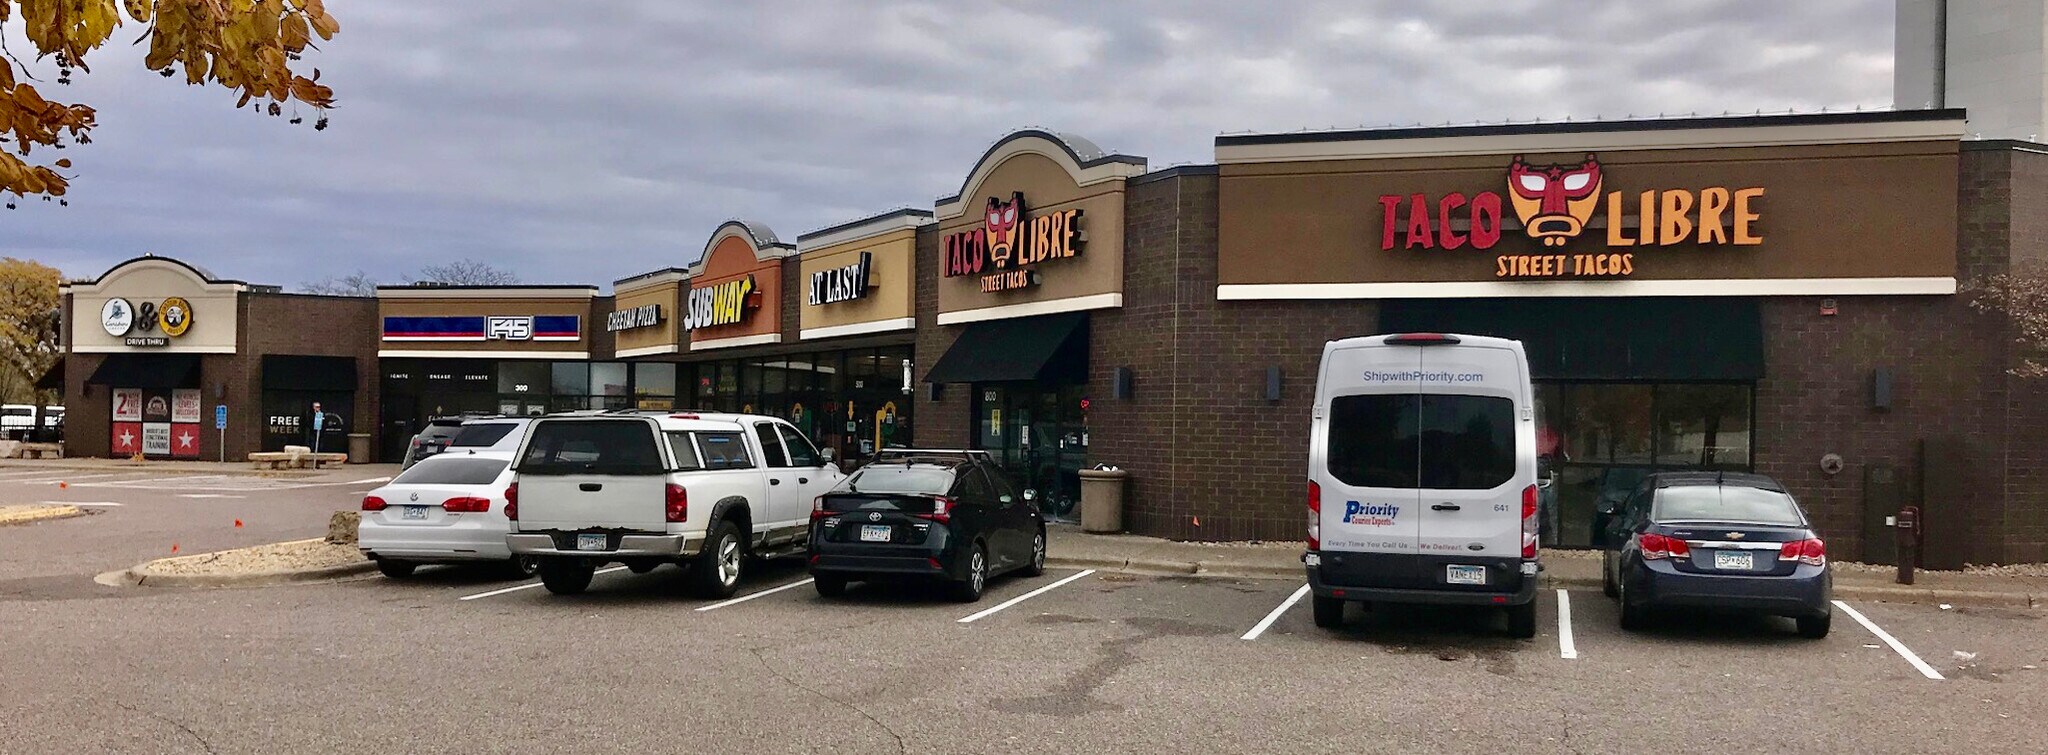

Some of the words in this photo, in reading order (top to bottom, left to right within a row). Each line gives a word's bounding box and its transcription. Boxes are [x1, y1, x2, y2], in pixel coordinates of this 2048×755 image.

[1378, 192, 1502, 250] TACO
[1607, 187, 1765, 246] LIBRE
[944, 228, 985, 277] TACO
[1018, 209, 1077, 265] LIBRE
[1496, 254, 1566, 276] STREET
[1574, 253, 1633, 275] TACOS
[808, 273, 824, 306] AT
[981, 273, 1004, 293] STREET
[1007, 270, 1028, 288] TACOS
[683, 275, 752, 332] SUBWAY
[488, 316, 531, 340] F45
[607, 307, 637, 332] CHEETAH
[637, 304, 657, 327] PIZZA
[127, 338, 146, 346] DRIVE
[147, 338, 164, 346] THRU
[1363, 370, 1483, 383] ShipwithPriority.com
[116, 393, 128, 414] 2
[985, 391, 997, 402] 800
[270, 416, 300, 425] FREE
[270, 426, 299, 434] WEEK
[1343, 501, 1399, 524] Priority
[1494, 504, 1509, 512] 641
[1352, 516, 1371, 525] Courier
[1372, 517, 1392, 528] Experts
[1328, 540, 1346, 548] Every
[1382, 541, 1396, 549] Call
